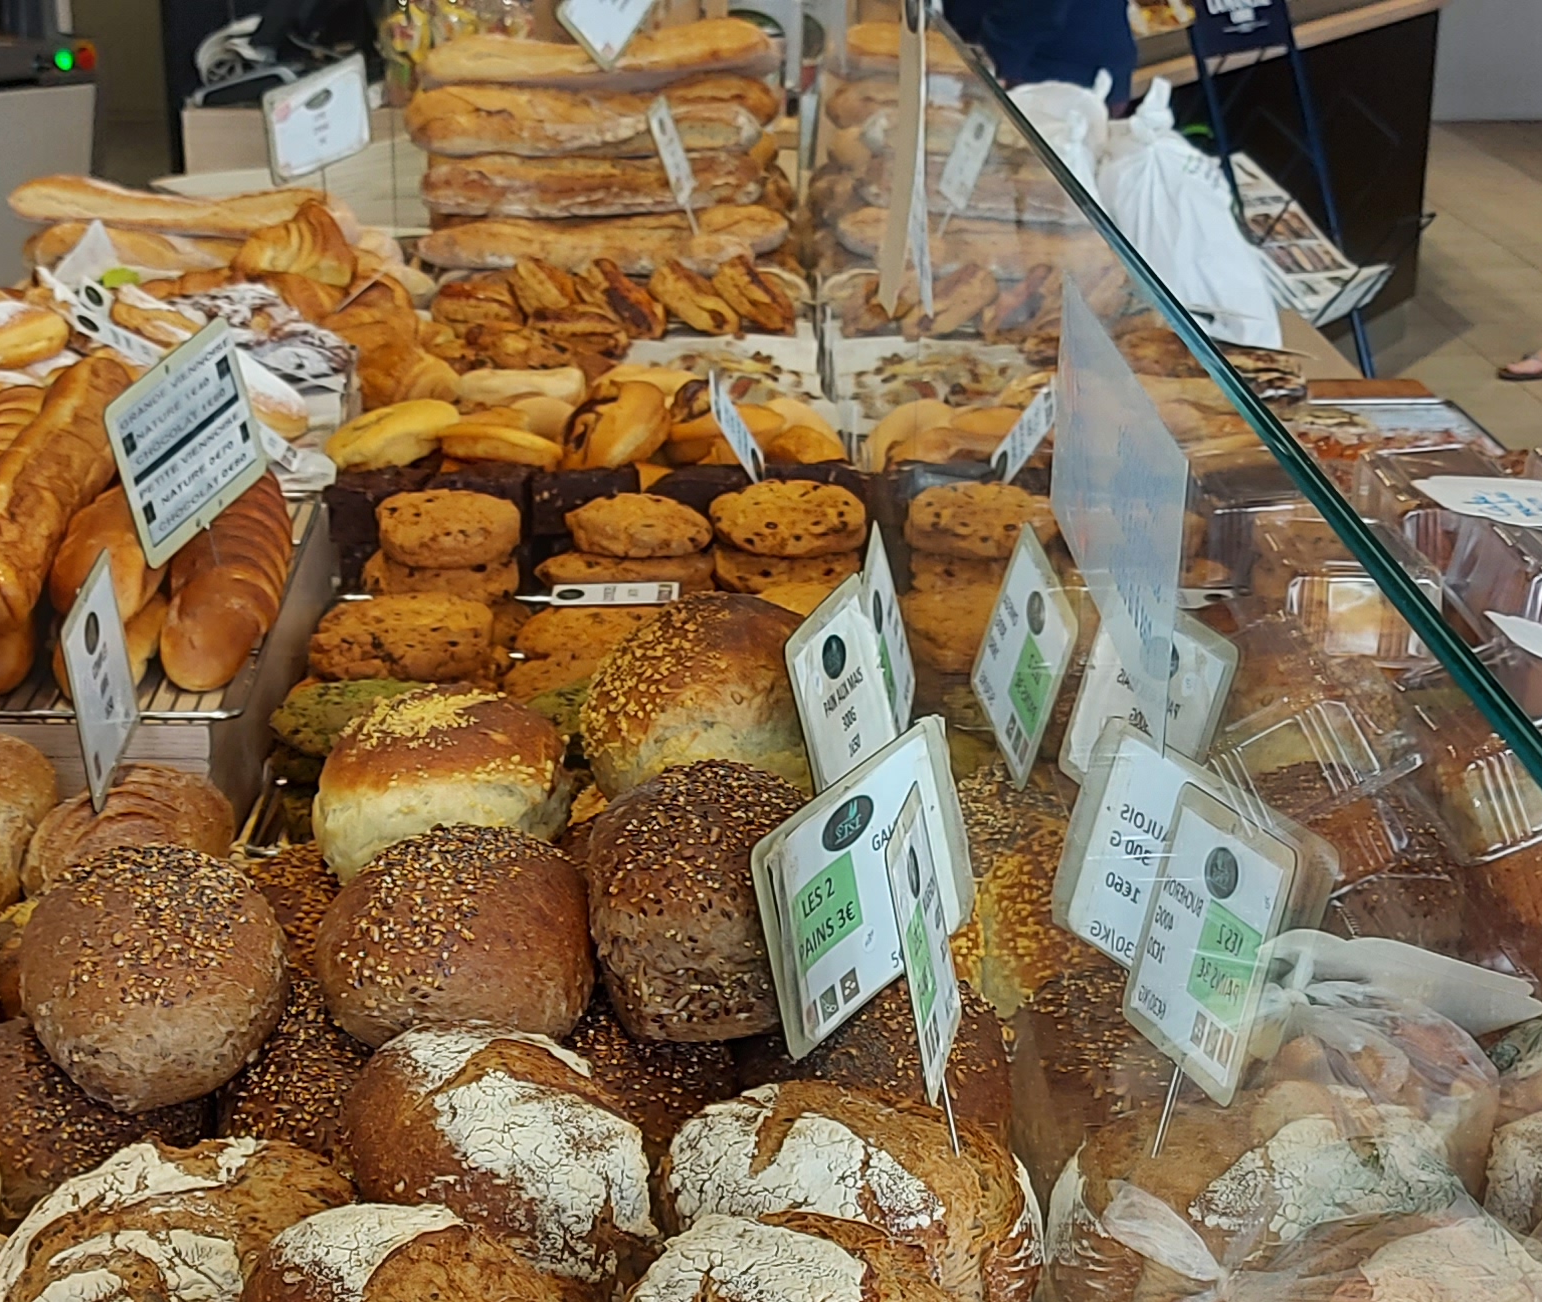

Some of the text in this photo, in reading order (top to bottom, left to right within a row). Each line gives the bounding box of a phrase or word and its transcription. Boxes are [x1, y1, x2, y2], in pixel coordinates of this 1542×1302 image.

[119, 386, 166, 431] GRANDE
[135, 402, 181, 440] NATURE
[134, 409, 198, 465] CHOCOLAT
[139, 411, 240, 500] PETITE VIENNOISE
[159, 475, 219, 533] CHOCOLAT
[161, 464, 207, 505] NATURE
[801, 877, 835, 919] LES 2
[798, 901, 856, 961] PAINS 3€
